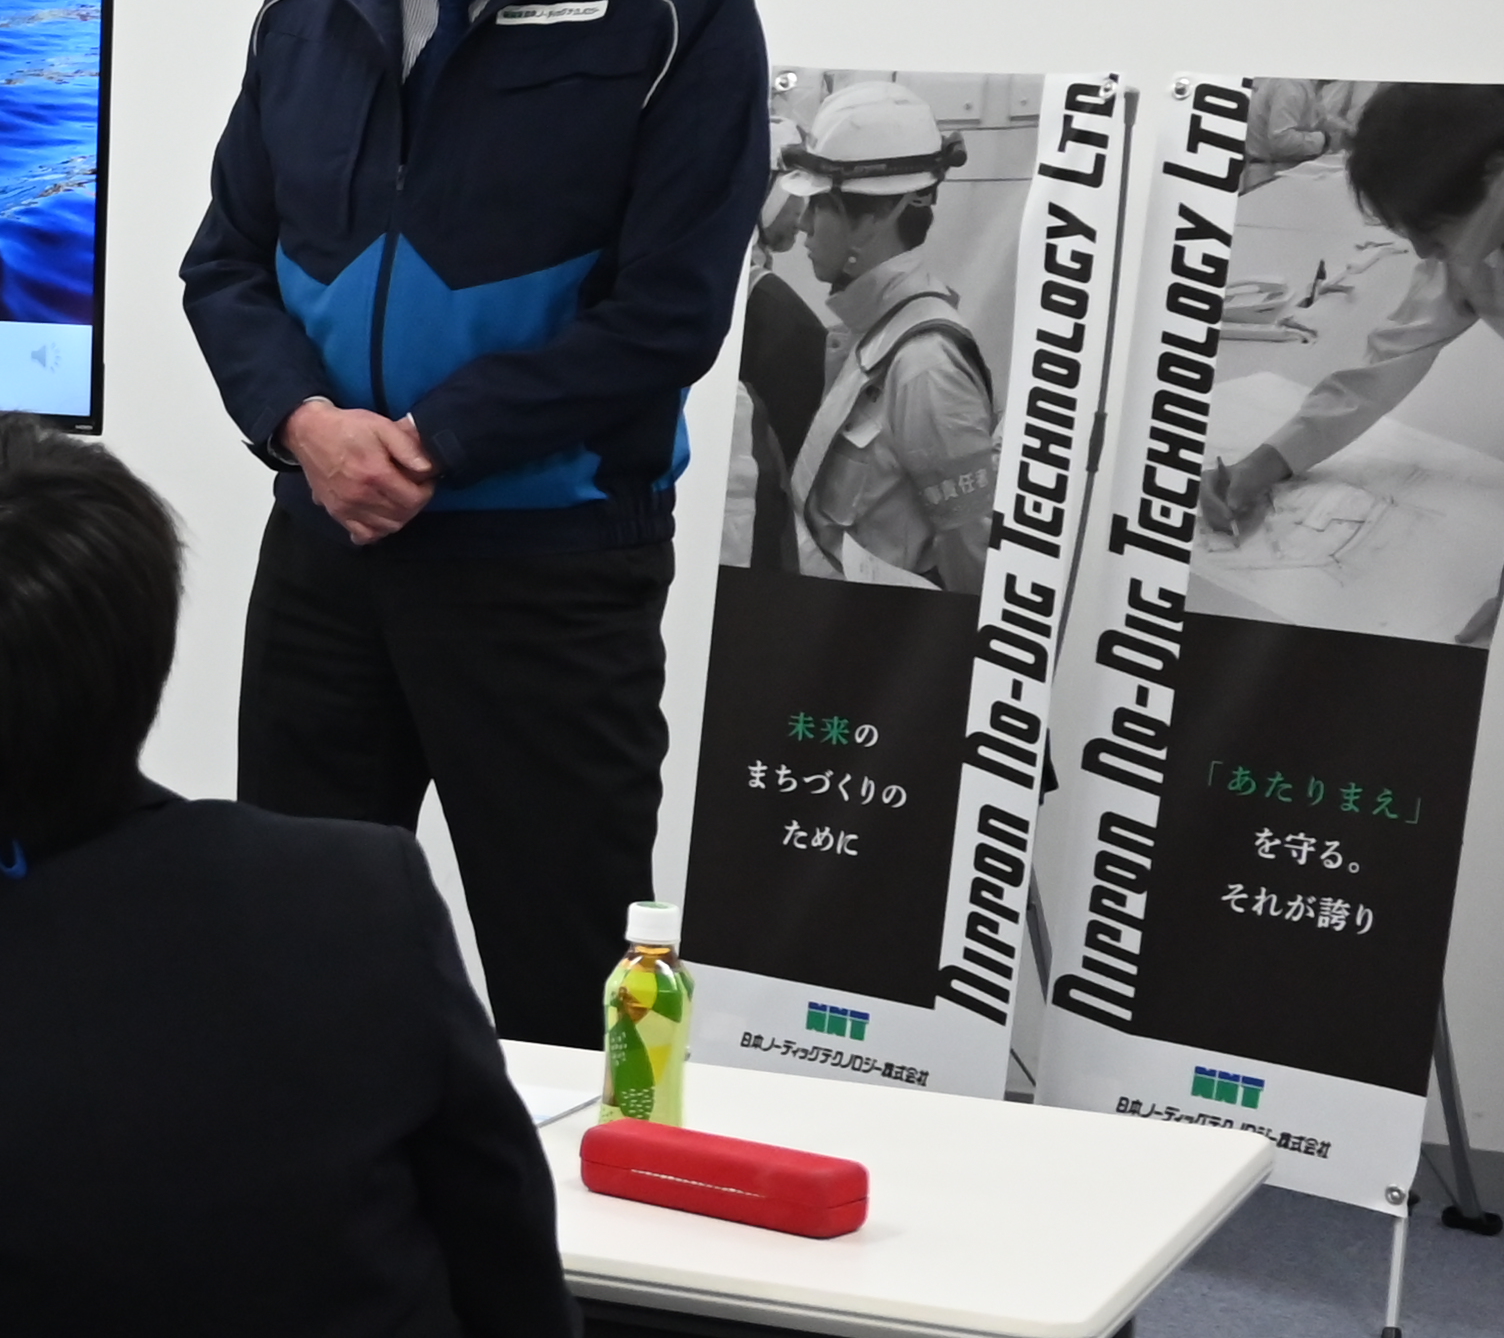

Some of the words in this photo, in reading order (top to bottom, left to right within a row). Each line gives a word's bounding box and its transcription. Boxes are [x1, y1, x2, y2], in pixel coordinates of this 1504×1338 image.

[788, 712, 879, 747] 未来の
[747, 760, 907, 808] まちづくりの
[1207, 760, 1421, 824] 「あたりまえ」
[782, 820, 859, 856] ために
[1254, 827, 1360, 874] を守る。
[1221, 883, 1374, 935] それが誇り
